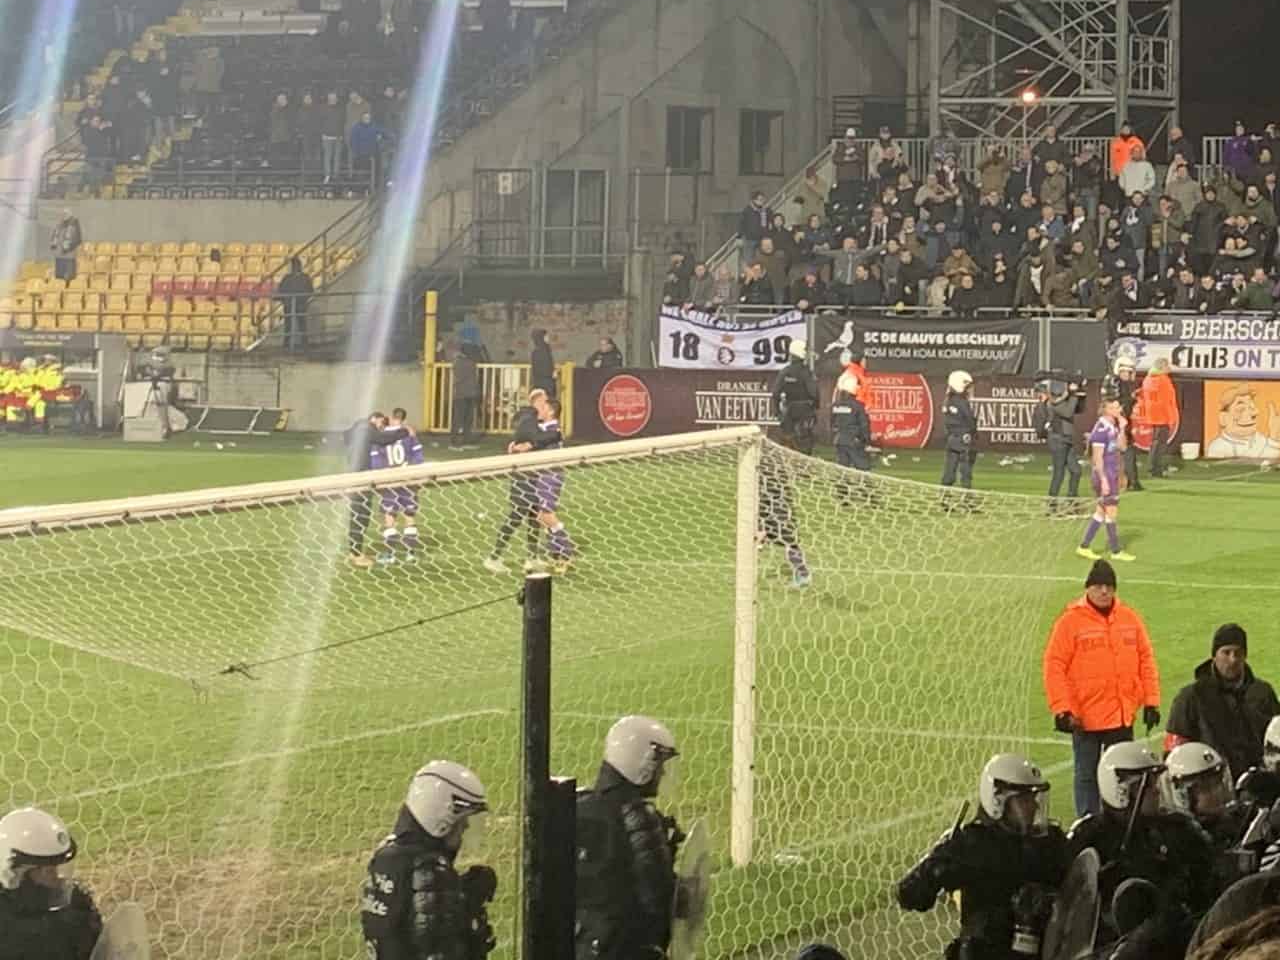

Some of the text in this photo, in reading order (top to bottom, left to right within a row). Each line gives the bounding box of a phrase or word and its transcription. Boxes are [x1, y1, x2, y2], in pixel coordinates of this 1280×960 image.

[1143, 322, 1174, 335] TEAM
[864, 332, 879, 344] SC
[881, 332, 897, 344] DE
[900, 333, 945, 345] MAUVE
[1234, 349, 1261, 368] ON
[872, 390, 924, 409] ETVELDE
[992, 387, 1035, 397] DRANK
[696, 396, 779, 421] VAN EETVEL
[1000, 403, 1037, 427] EETV
[991, 432, 1046, 443] LOKERE
[386, 444, 405, 465] 10
